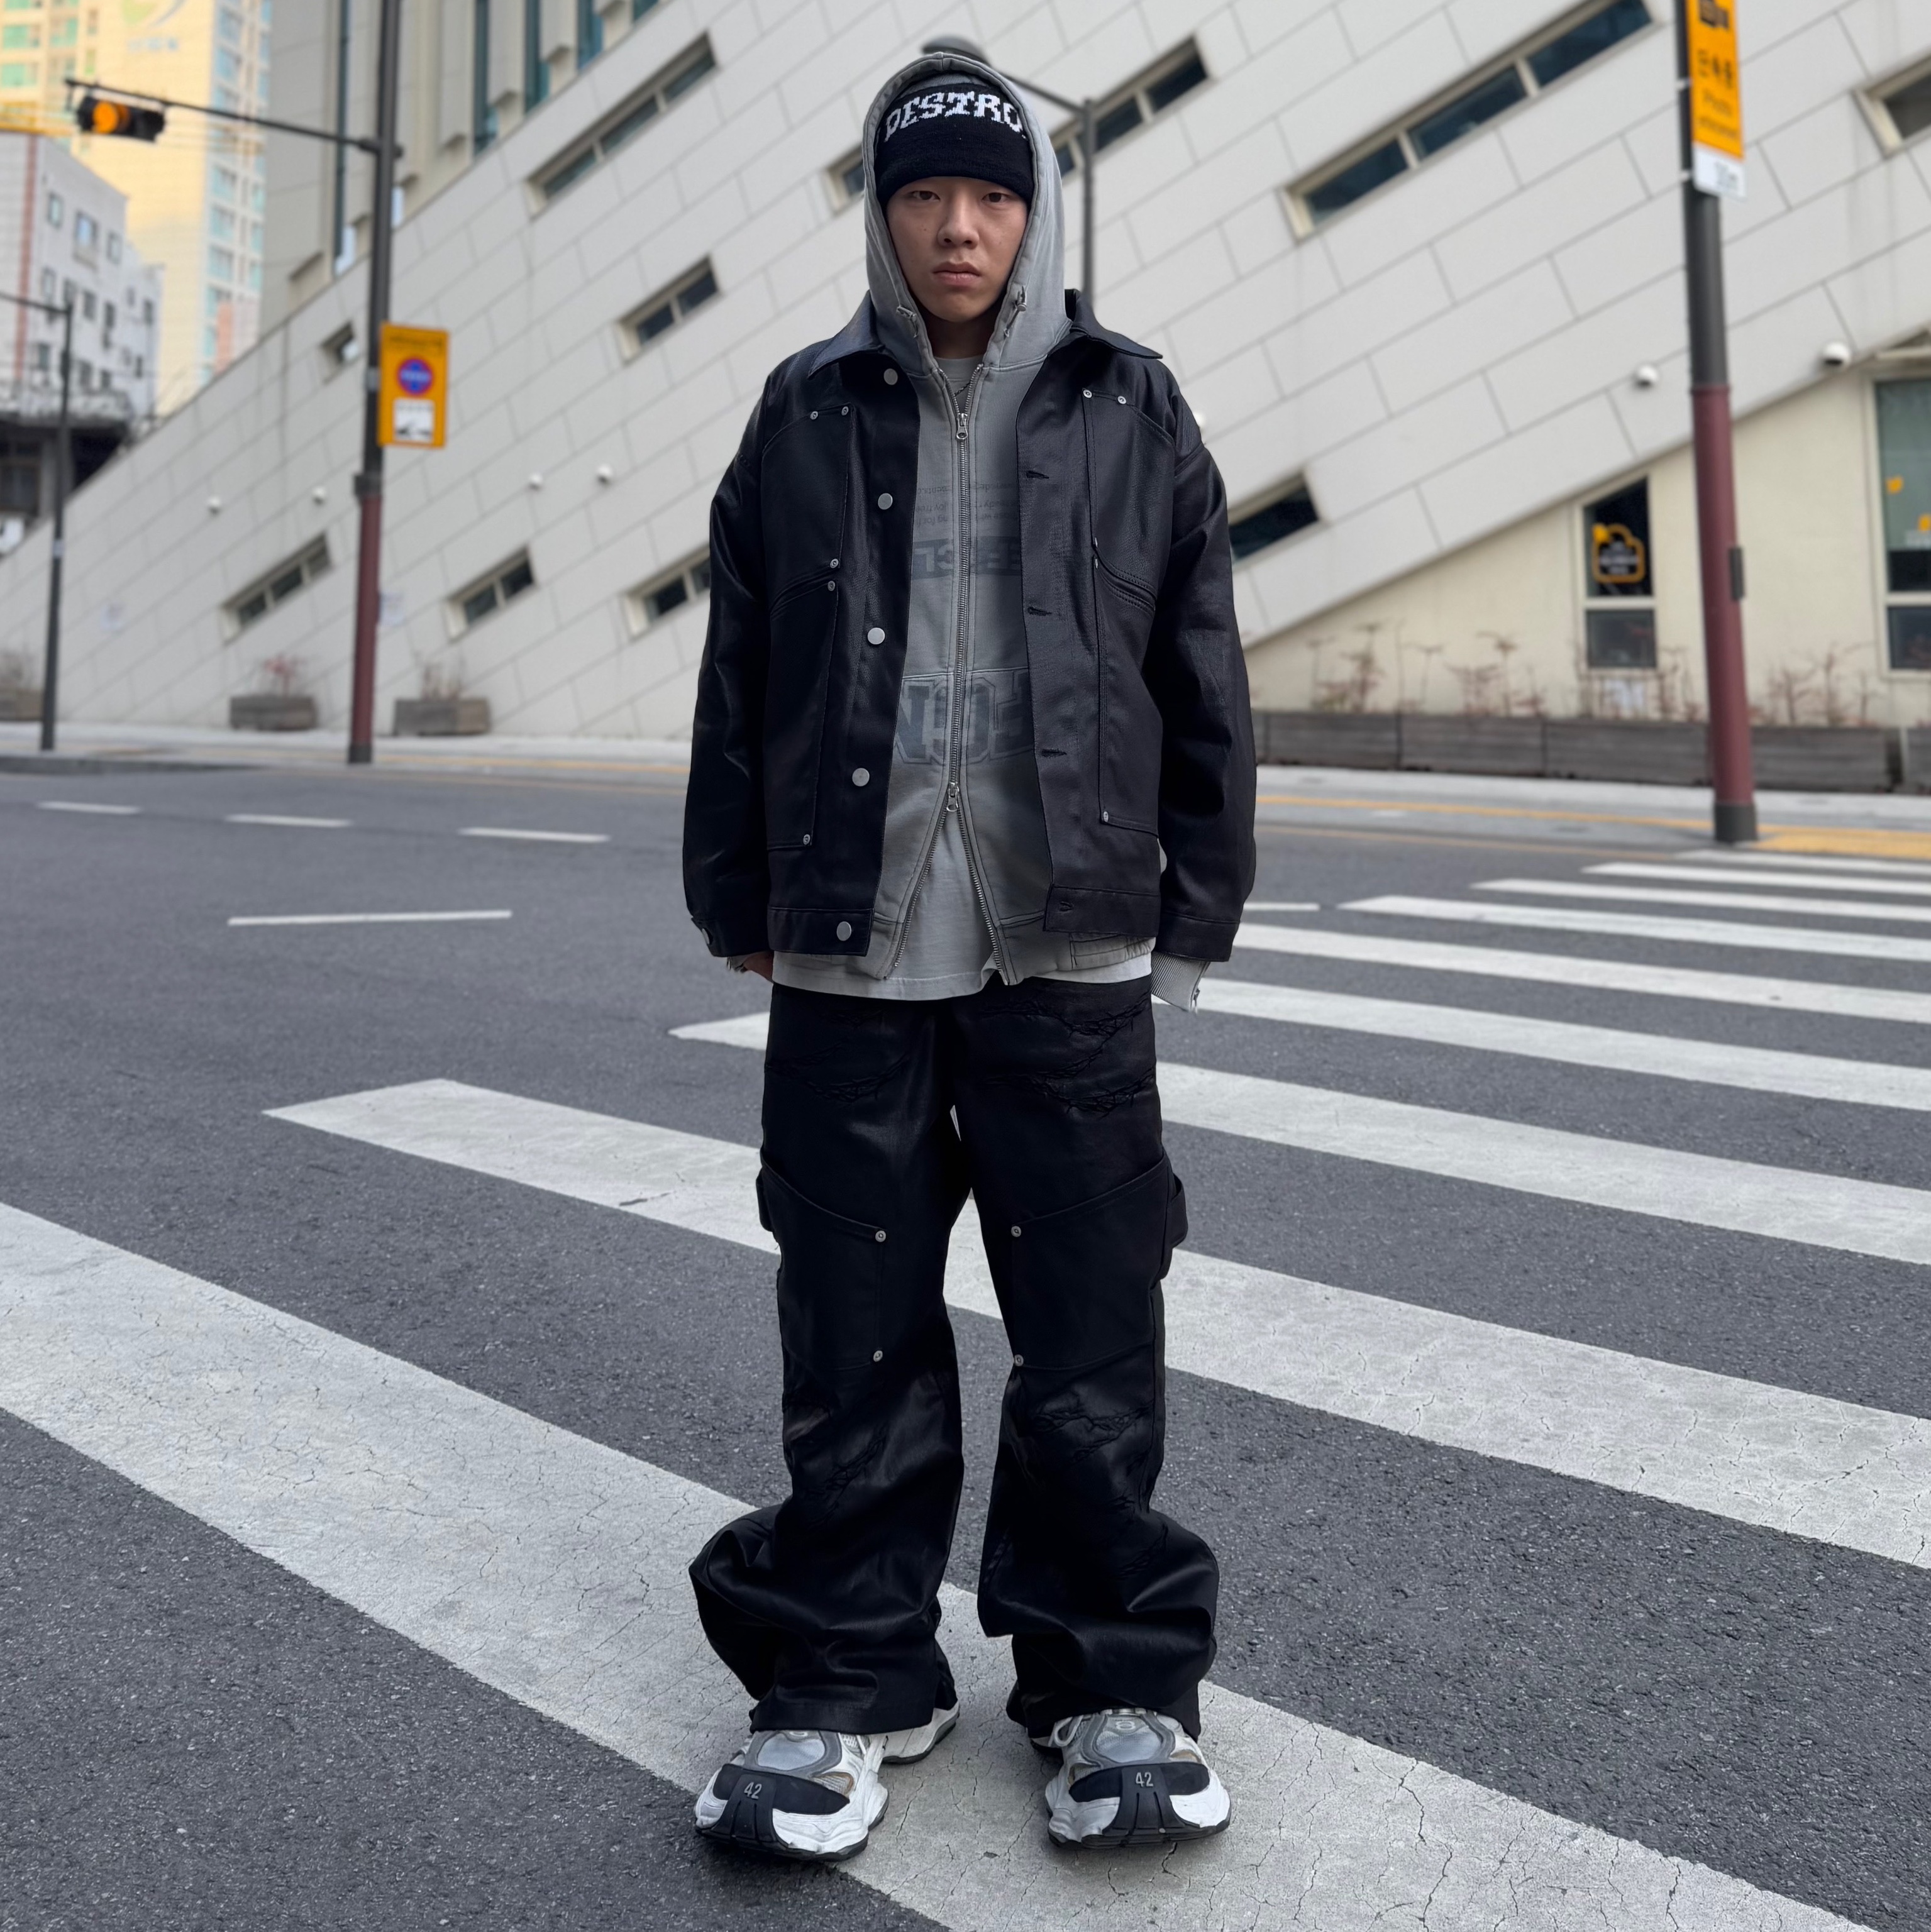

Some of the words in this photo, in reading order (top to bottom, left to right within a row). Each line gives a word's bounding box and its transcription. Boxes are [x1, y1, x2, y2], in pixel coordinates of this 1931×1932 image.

[884, 91, 1026, 142] DESTRO
[1136, 1772, 1154, 1787] 42
[744, 1782, 762, 1799] 42
